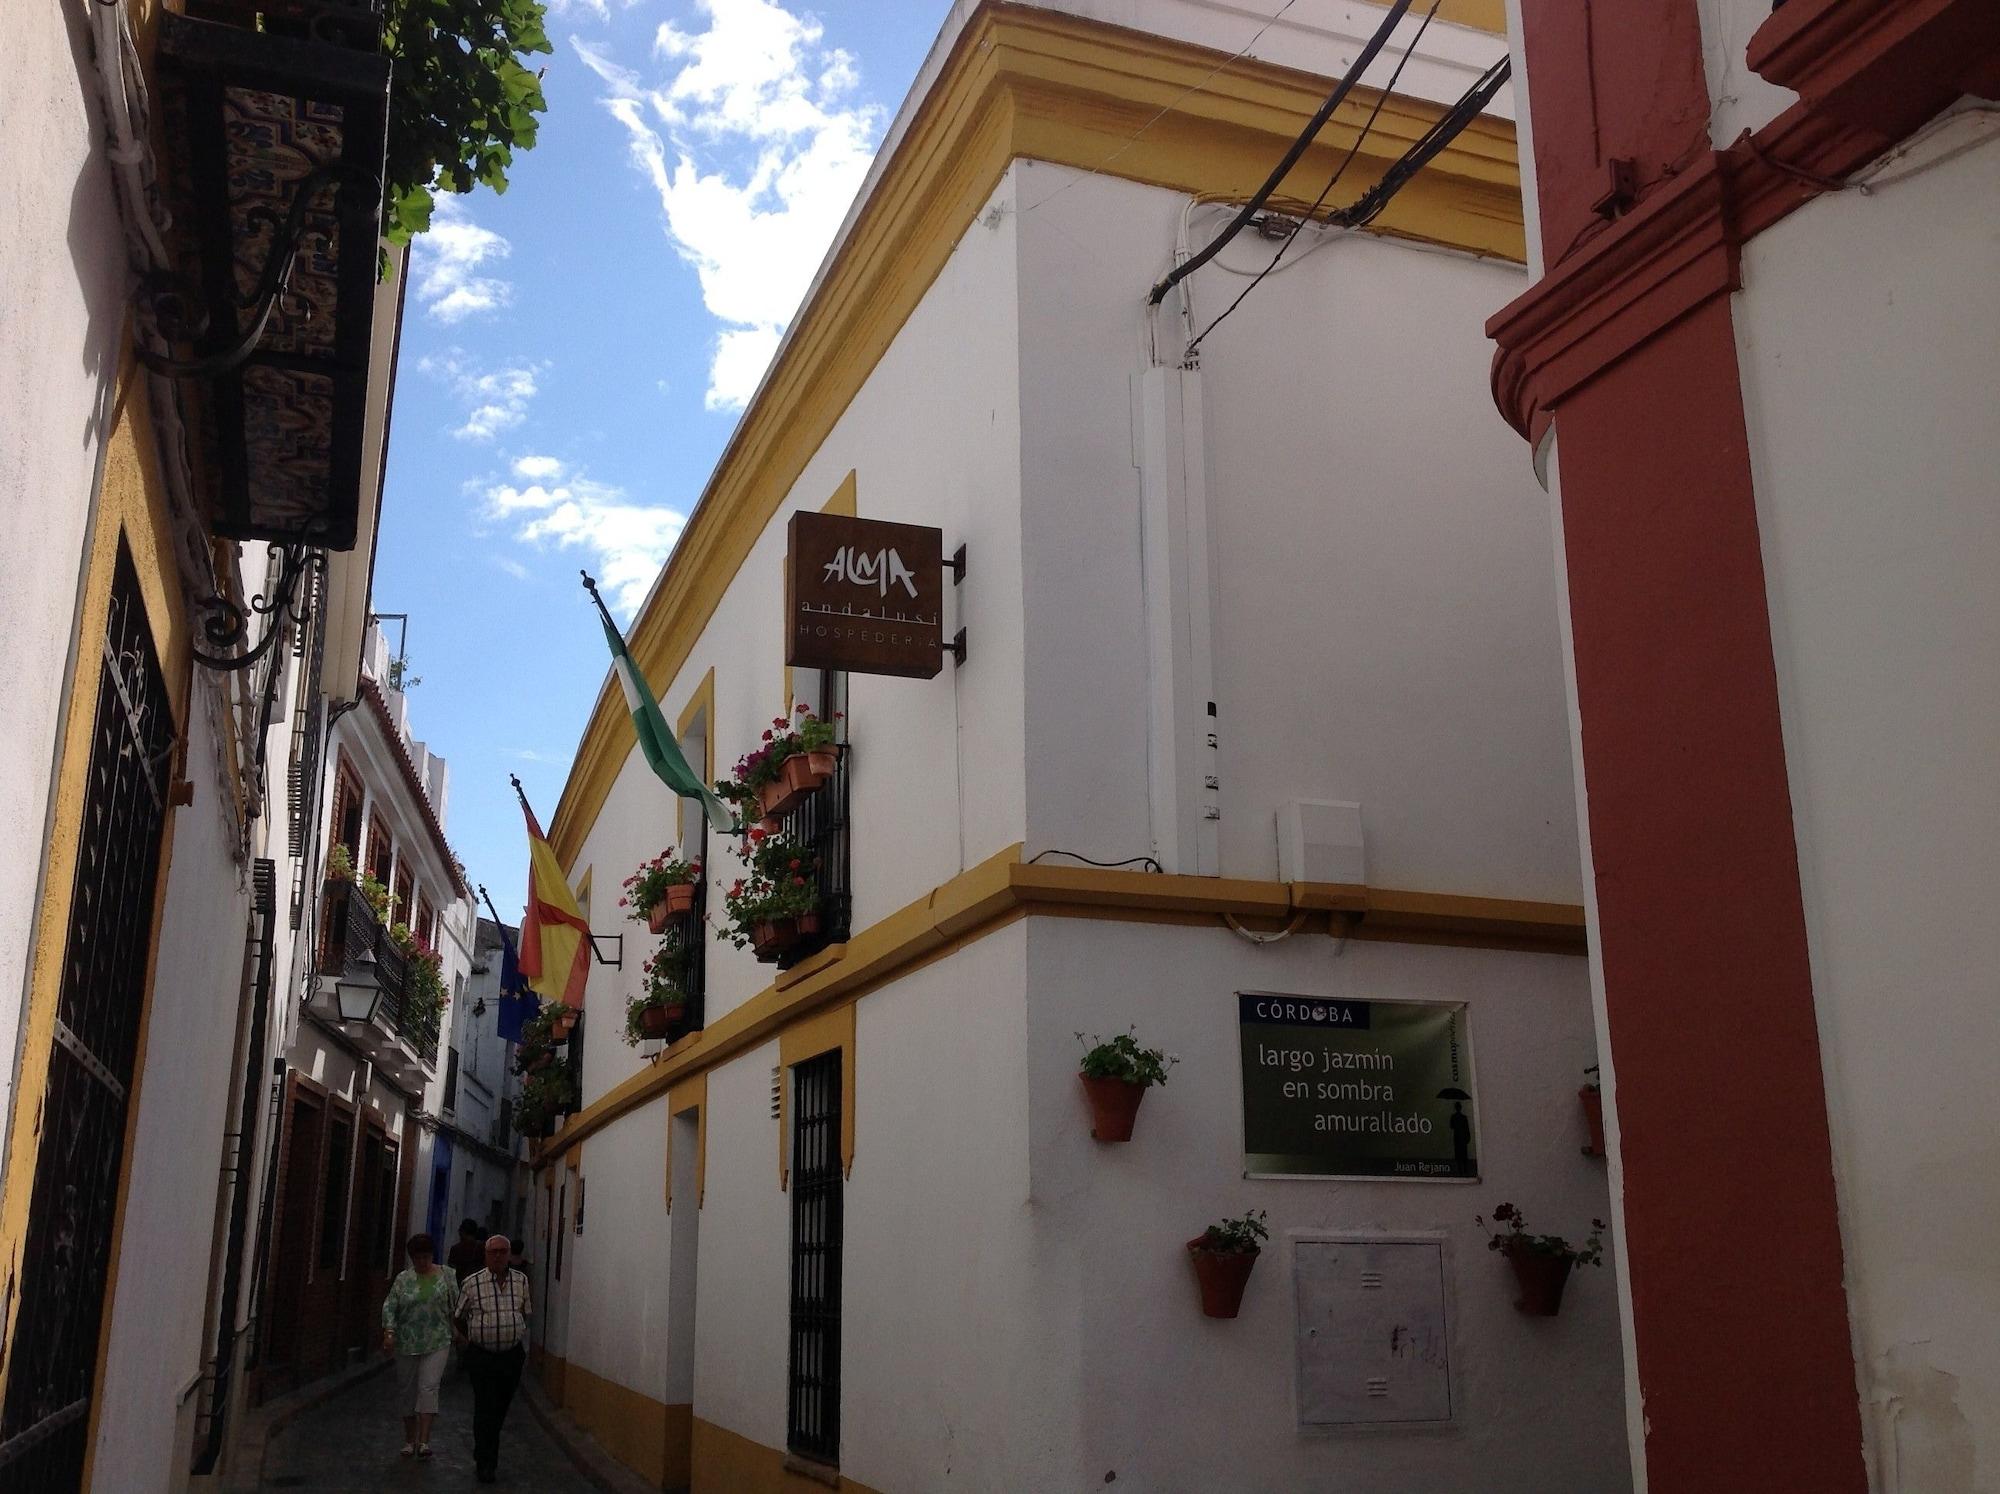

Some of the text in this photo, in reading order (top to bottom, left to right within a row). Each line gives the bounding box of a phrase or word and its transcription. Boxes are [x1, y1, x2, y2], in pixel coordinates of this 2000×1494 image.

[823, 546, 918, 599] ALMA
[802, 602, 937, 625] andalusi
[1256, 1000, 1353, 1023] CÓRDOBA
[1258, 1044, 1315, 1072] largo
[1282, 1079, 1394, 1102] en sombra
[1314, 1112, 1433, 1135] amurallado
[1394, 1161, 1417, 1172] Juan
